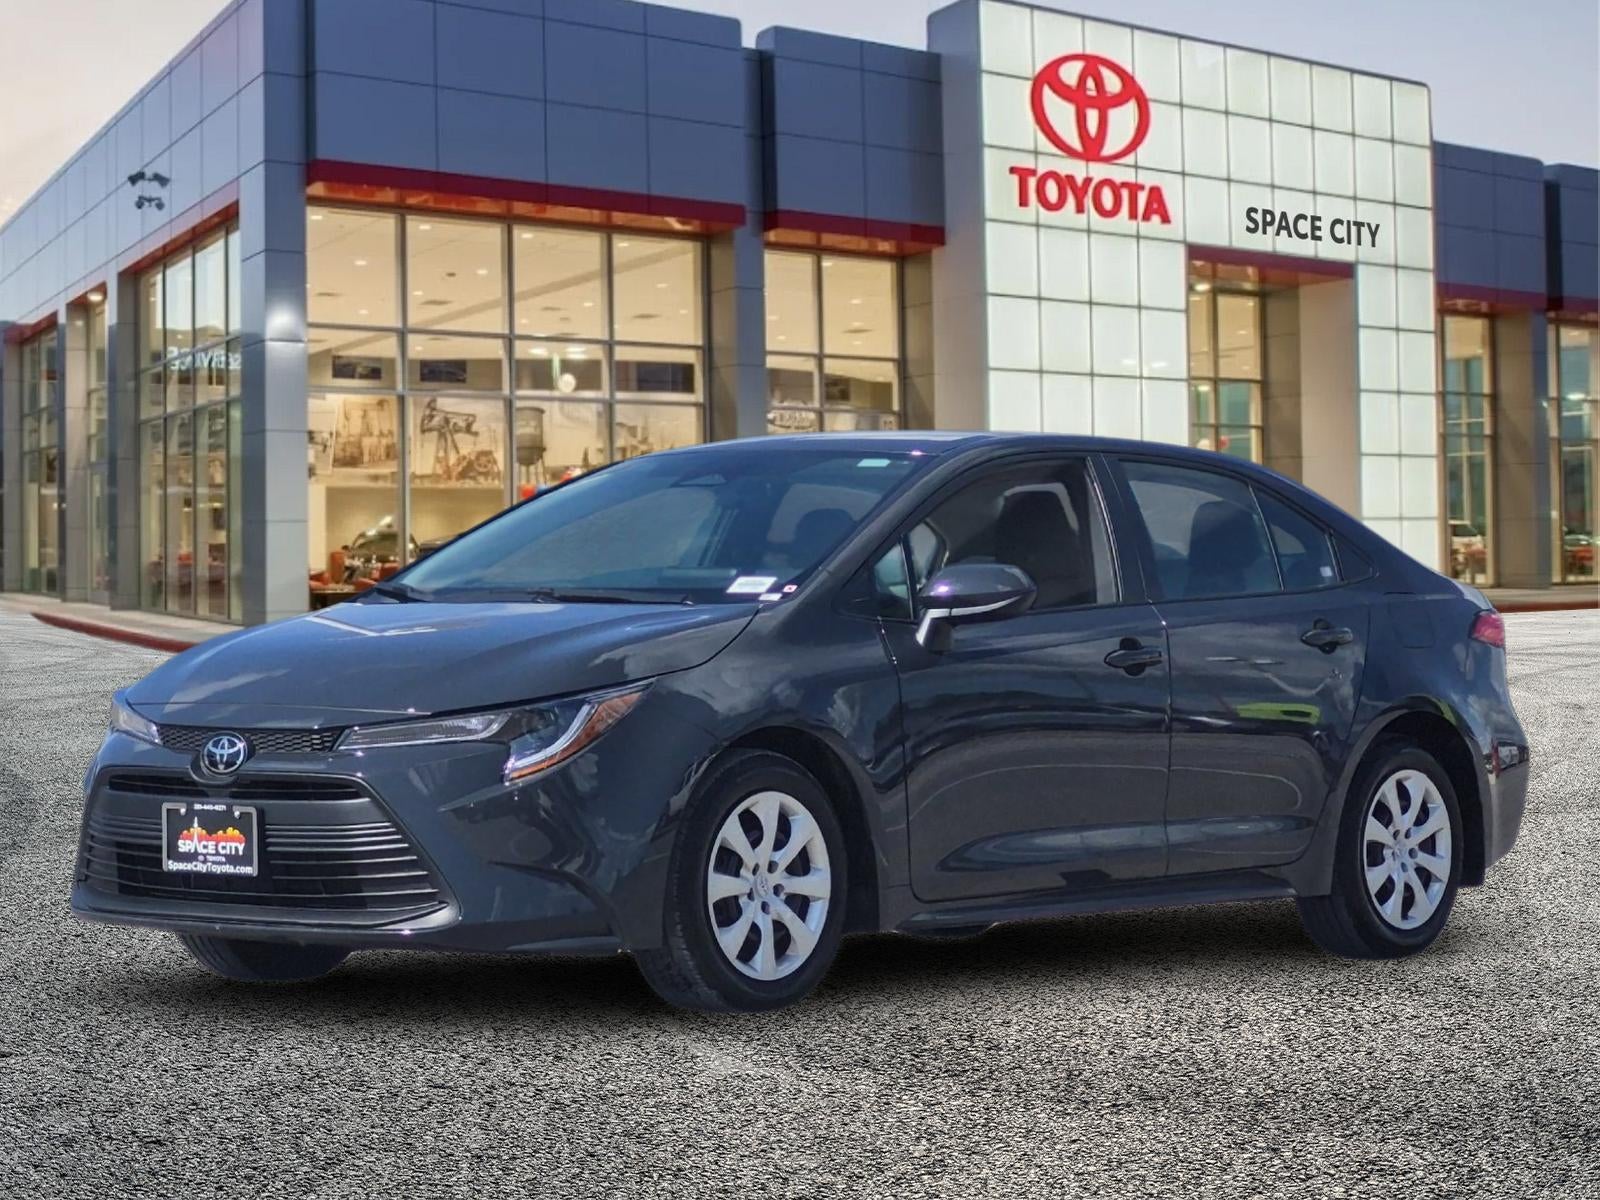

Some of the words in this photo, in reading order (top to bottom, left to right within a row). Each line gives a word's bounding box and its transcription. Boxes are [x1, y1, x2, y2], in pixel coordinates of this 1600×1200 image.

[1008, 166, 1172, 225] TOYOTA
[1244, 206, 1323, 242] SPACE
[1329, 218, 1381, 248] CITY
[178, 839, 216, 854] SPACE
[218, 841, 245, 855] CITY
[168, 860, 253, 873] SpaceCityToyota.com
